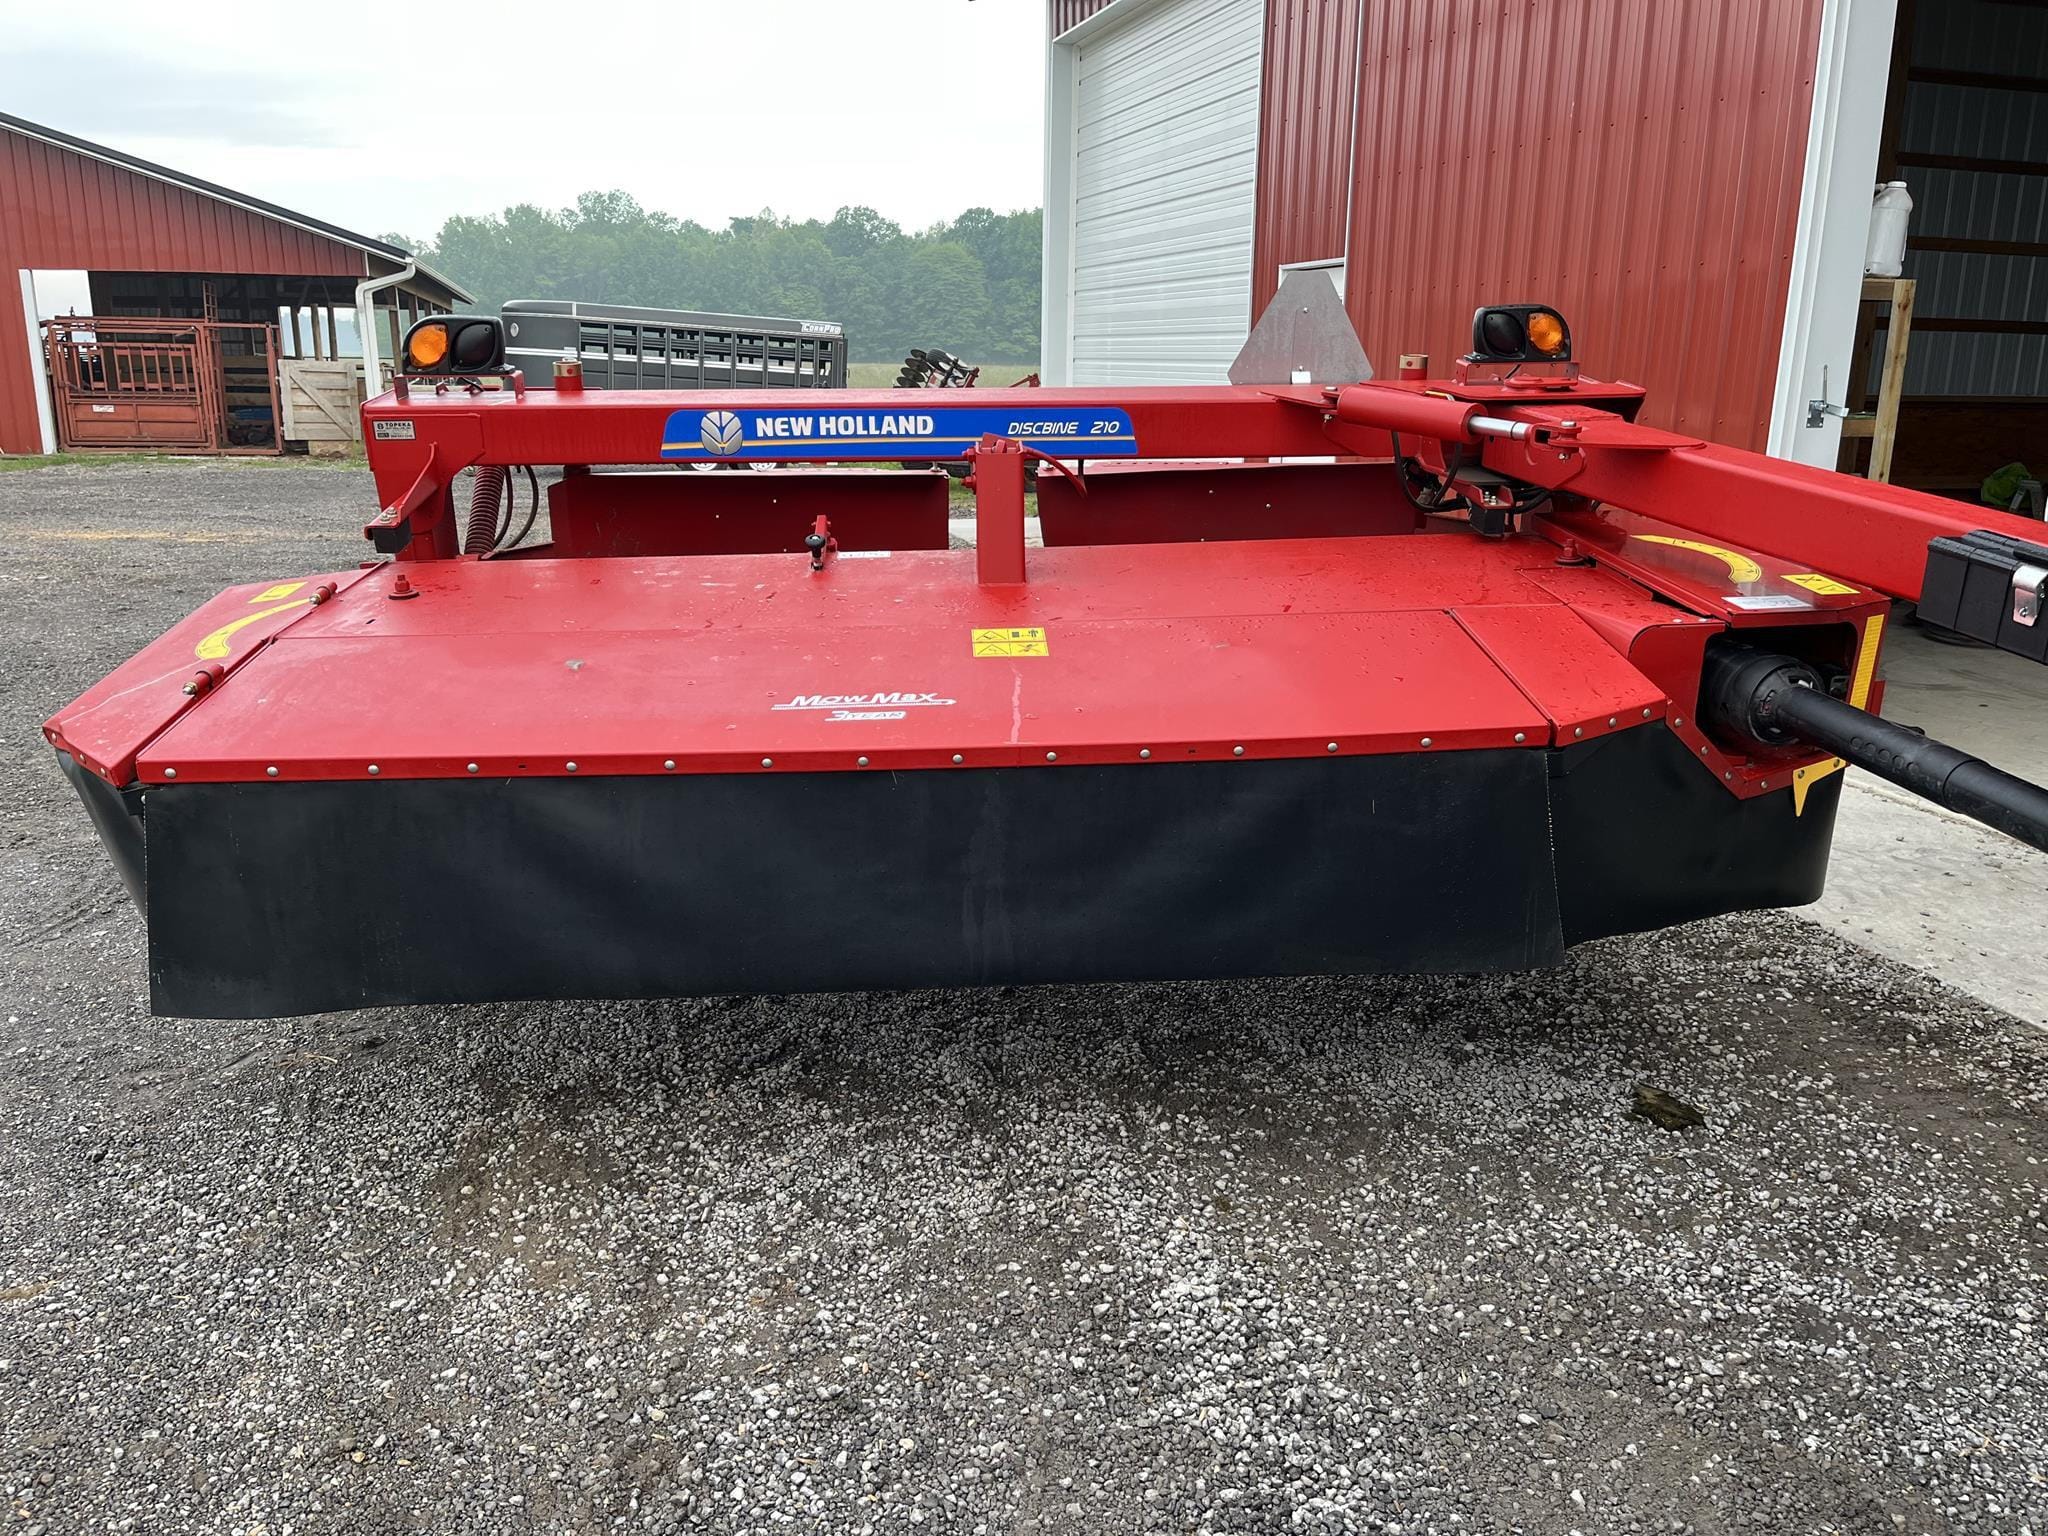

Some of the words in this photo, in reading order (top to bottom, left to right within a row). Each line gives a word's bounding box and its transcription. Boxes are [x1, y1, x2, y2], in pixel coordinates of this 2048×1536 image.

[755, 416, 813, 437] NEW
[819, 415, 934, 436] HOLLAND
[1007, 421, 1079, 435] DISCBINE
[1090, 421, 1120, 434] 210
[789, 695, 868, 707] Mow
[870, 692, 939, 703] Max
